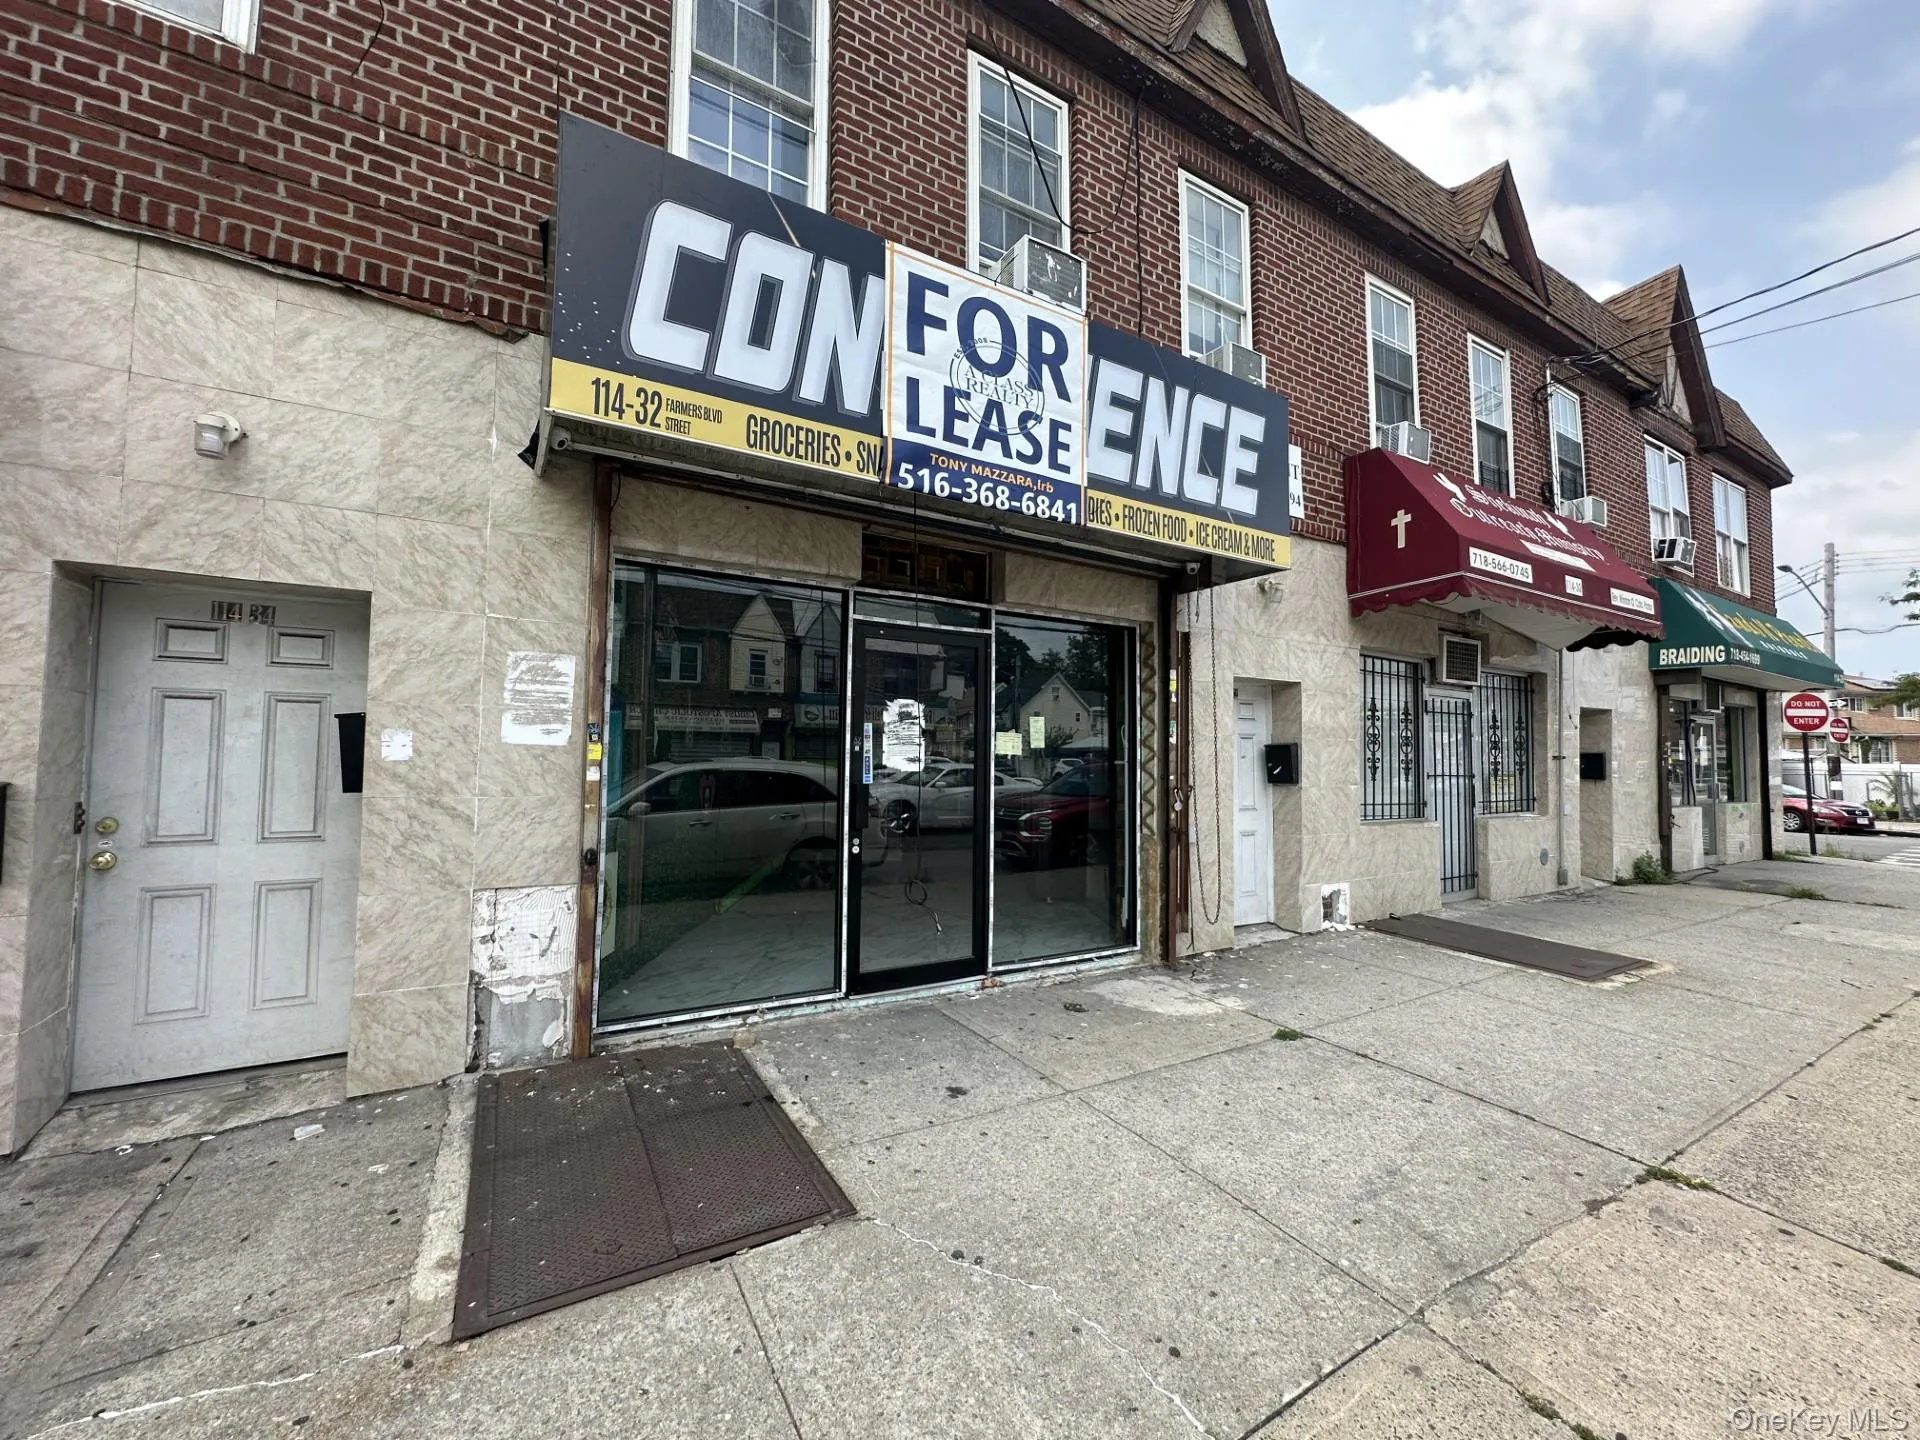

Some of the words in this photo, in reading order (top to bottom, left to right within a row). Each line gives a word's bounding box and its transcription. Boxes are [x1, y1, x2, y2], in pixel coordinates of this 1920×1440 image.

[907, 271, 1072, 403] FOR
[591, 377, 663, 428] 114-32
[666, 398, 703, 420] FARMERS
[703, 405, 723, 424] BLVD
[966, 377, 1034, 408] REALTY
[665, 416, 692, 435] STREET
[907, 376, 1072, 475] LEASE
[1087, 354, 1265, 516] ENCE
[928, 452, 968, 473] TONY
[746, 413, 841, 467] GROCERIES
[1122, 503, 1160, 538] FROZEN
[1162, 513, 1187, 543] FOOD
[1196, 521, 1210, 548] ICE
[1211, 525, 1243, 555] CREAM
[1244, 533, 1250, 556] &
[1251, 534, 1276, 562] MORE
[897, 462, 1077, 524] 516-368-6841
[1450, 497, 1541, 543] Outreach
[1472, 552, 1530, 579] 718-566-0745
[1659, 645, 1726, 665] BRAIDING
